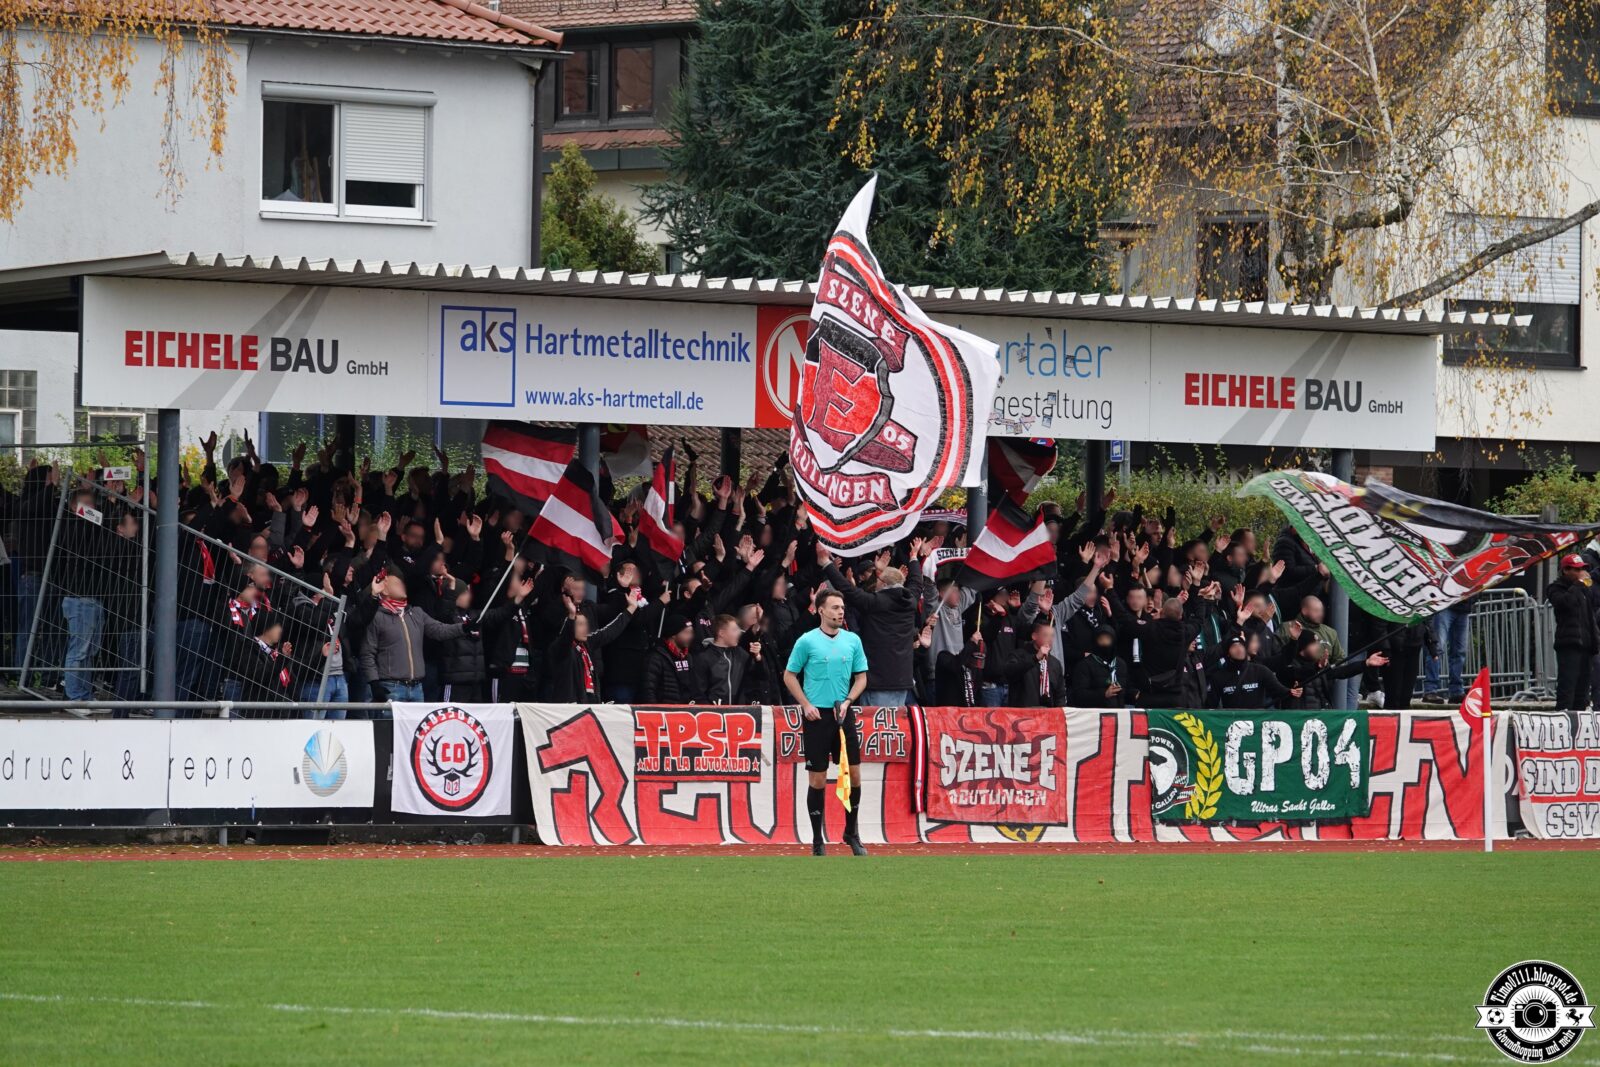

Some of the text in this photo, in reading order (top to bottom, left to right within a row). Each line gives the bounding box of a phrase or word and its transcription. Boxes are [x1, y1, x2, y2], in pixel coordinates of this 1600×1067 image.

[827, 278, 896, 346] SZENE
[125, 330, 389, 376] EICHELE BAU GmbH
[459, 319, 515, 355] aks
[525, 323, 750, 363] Hartmetalltechnik
[525, 388, 704, 411] www.aks-hartmetall.de
[1185, 372, 1404, 414] EICHELE BAU GmbH
[883, 426, 910, 451] 05
[635, 711, 756, 759] TPSP
[873, 706, 898, 730] AI
[1513, 711, 1573, 750] WIR
[2, 750, 252, 787] druck & repro
[643, 757, 660, 771] NO
[677, 756, 691, 771] LA
[694, 757, 750, 772] AUTORIDAD
[939, 733, 1032, 788] SZENE
[1520, 758, 1579, 795] SIND
[948, 788, 1047, 806] REUTLINGEN
[1250, 798, 1336, 814] Ultras Sankt Gallen
[1546, 803, 1600, 837] SSV
